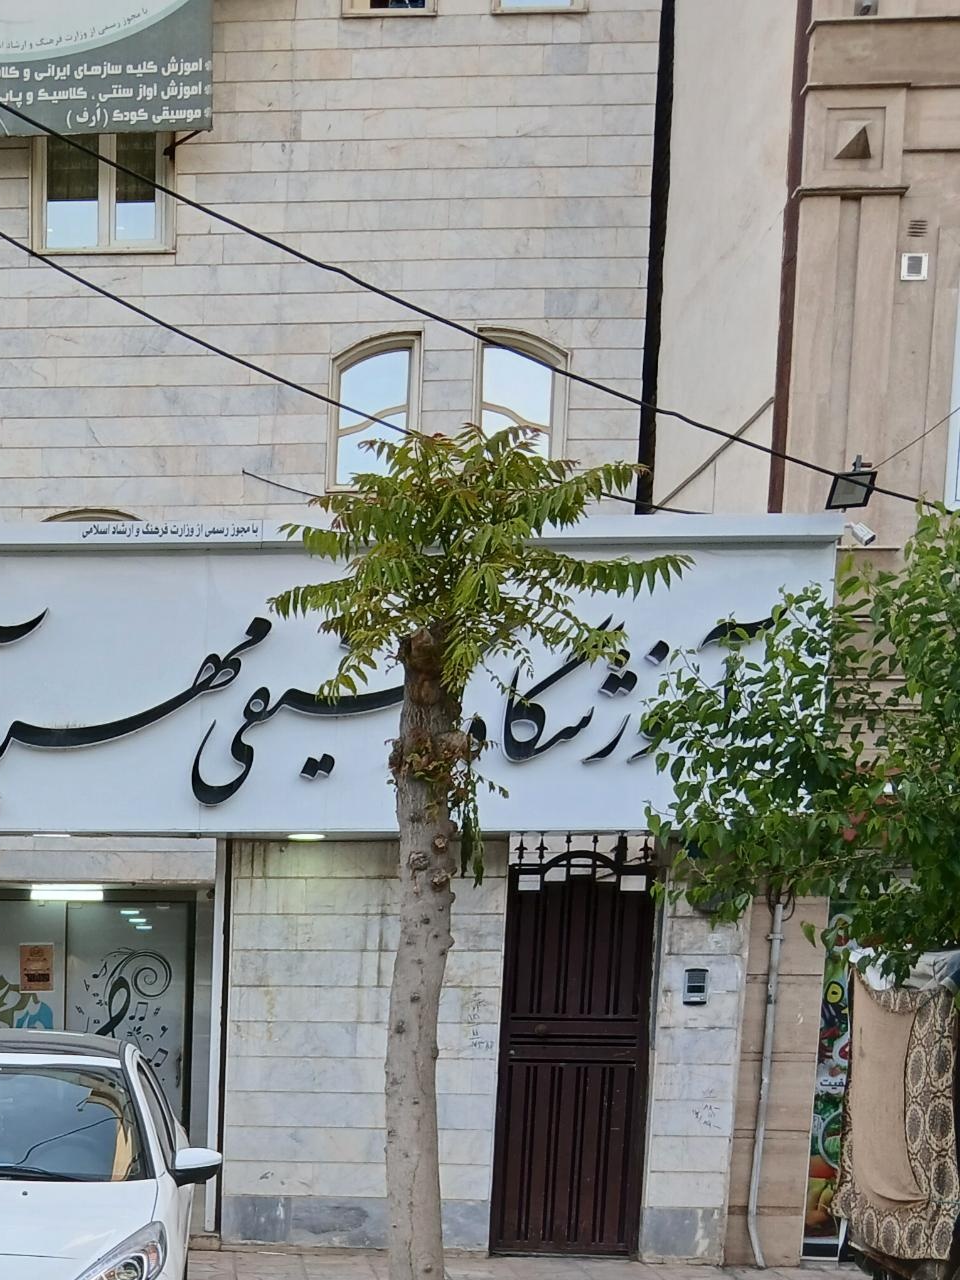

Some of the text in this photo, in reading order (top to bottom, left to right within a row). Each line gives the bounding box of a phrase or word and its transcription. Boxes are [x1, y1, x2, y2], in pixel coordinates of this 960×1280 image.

[23, 69, 31, 81] و
[34, 66, 71, 82] ایرانی
[74, 64, 122, 80] سازهای
[126, 60, 158, 77] کلیه
[26, 93, 34, 105] و
[37, 87, 88, 104] کلاسیک
[112, 108, 148, 124] کودک
[152, 107, 202, 123] موسیقی
[81, 523, 259, 539] با مجوز رسمی از وزارت فرهنگ و ارشاد اسلامی
[465, 606, 790, 767] آوزشگاه
